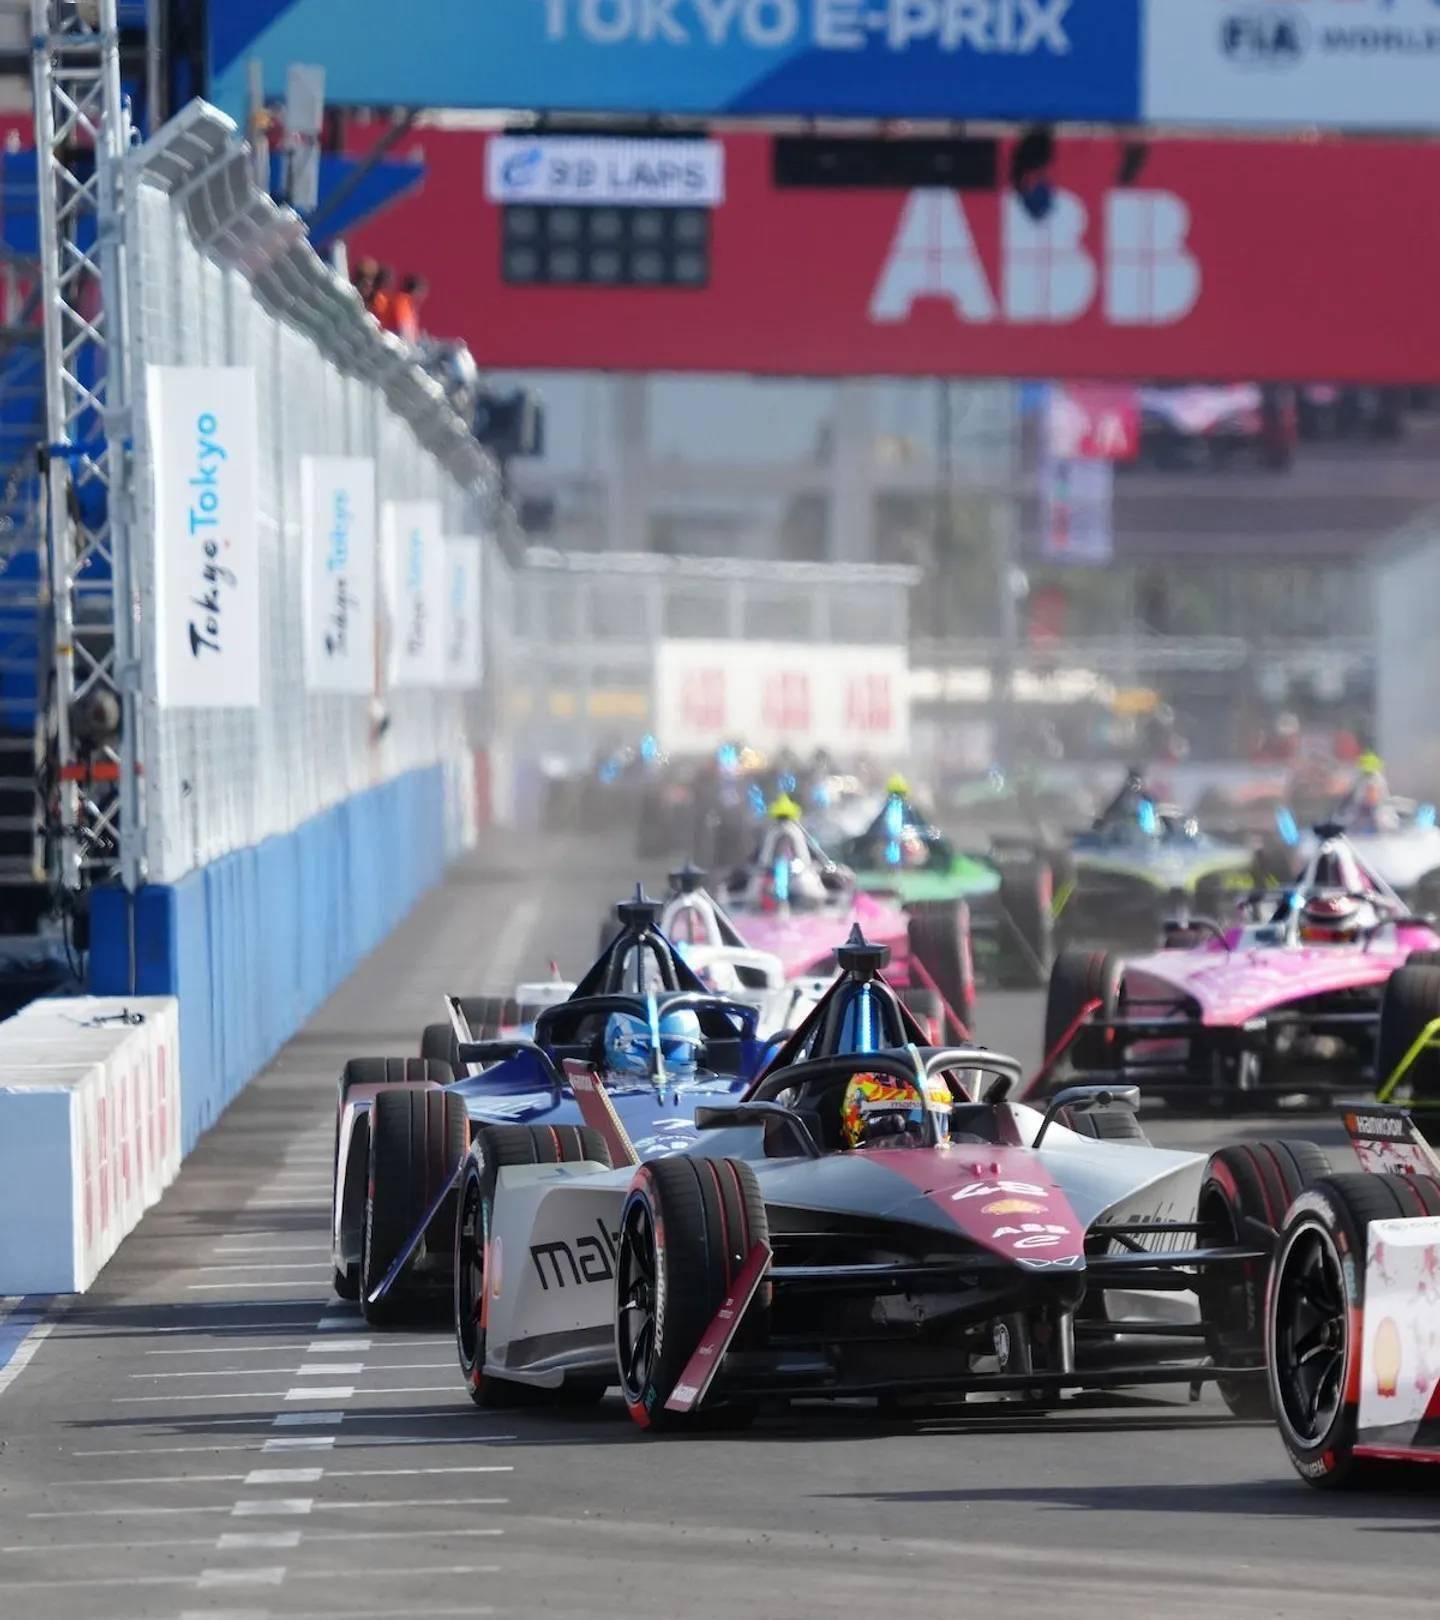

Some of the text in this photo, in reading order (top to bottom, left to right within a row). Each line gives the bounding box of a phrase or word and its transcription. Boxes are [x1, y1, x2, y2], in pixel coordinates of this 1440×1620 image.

[868, 185, 1202, 326] ABB
[188, 411, 238, 660] Tokyo Tokyo
